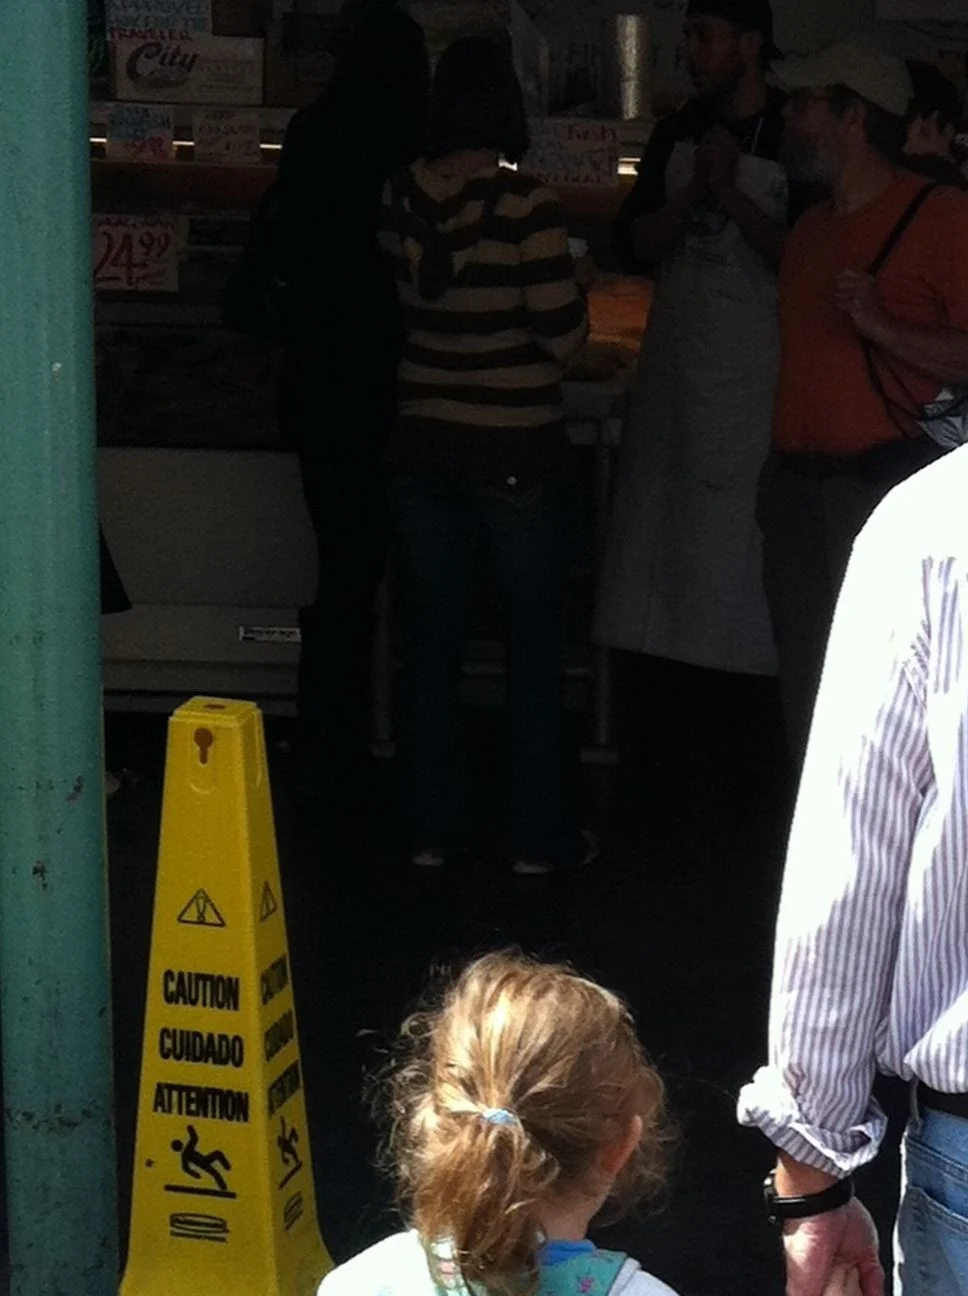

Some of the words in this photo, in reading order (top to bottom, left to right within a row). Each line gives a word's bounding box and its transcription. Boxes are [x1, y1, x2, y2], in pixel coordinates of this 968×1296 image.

[126, 41, 200, 82] City
[164, 969, 240, 1011] CAUTION
[159, 1027, 244, 1069] CUIDADO
[153, 1081, 250, 1123] ATTENTION
